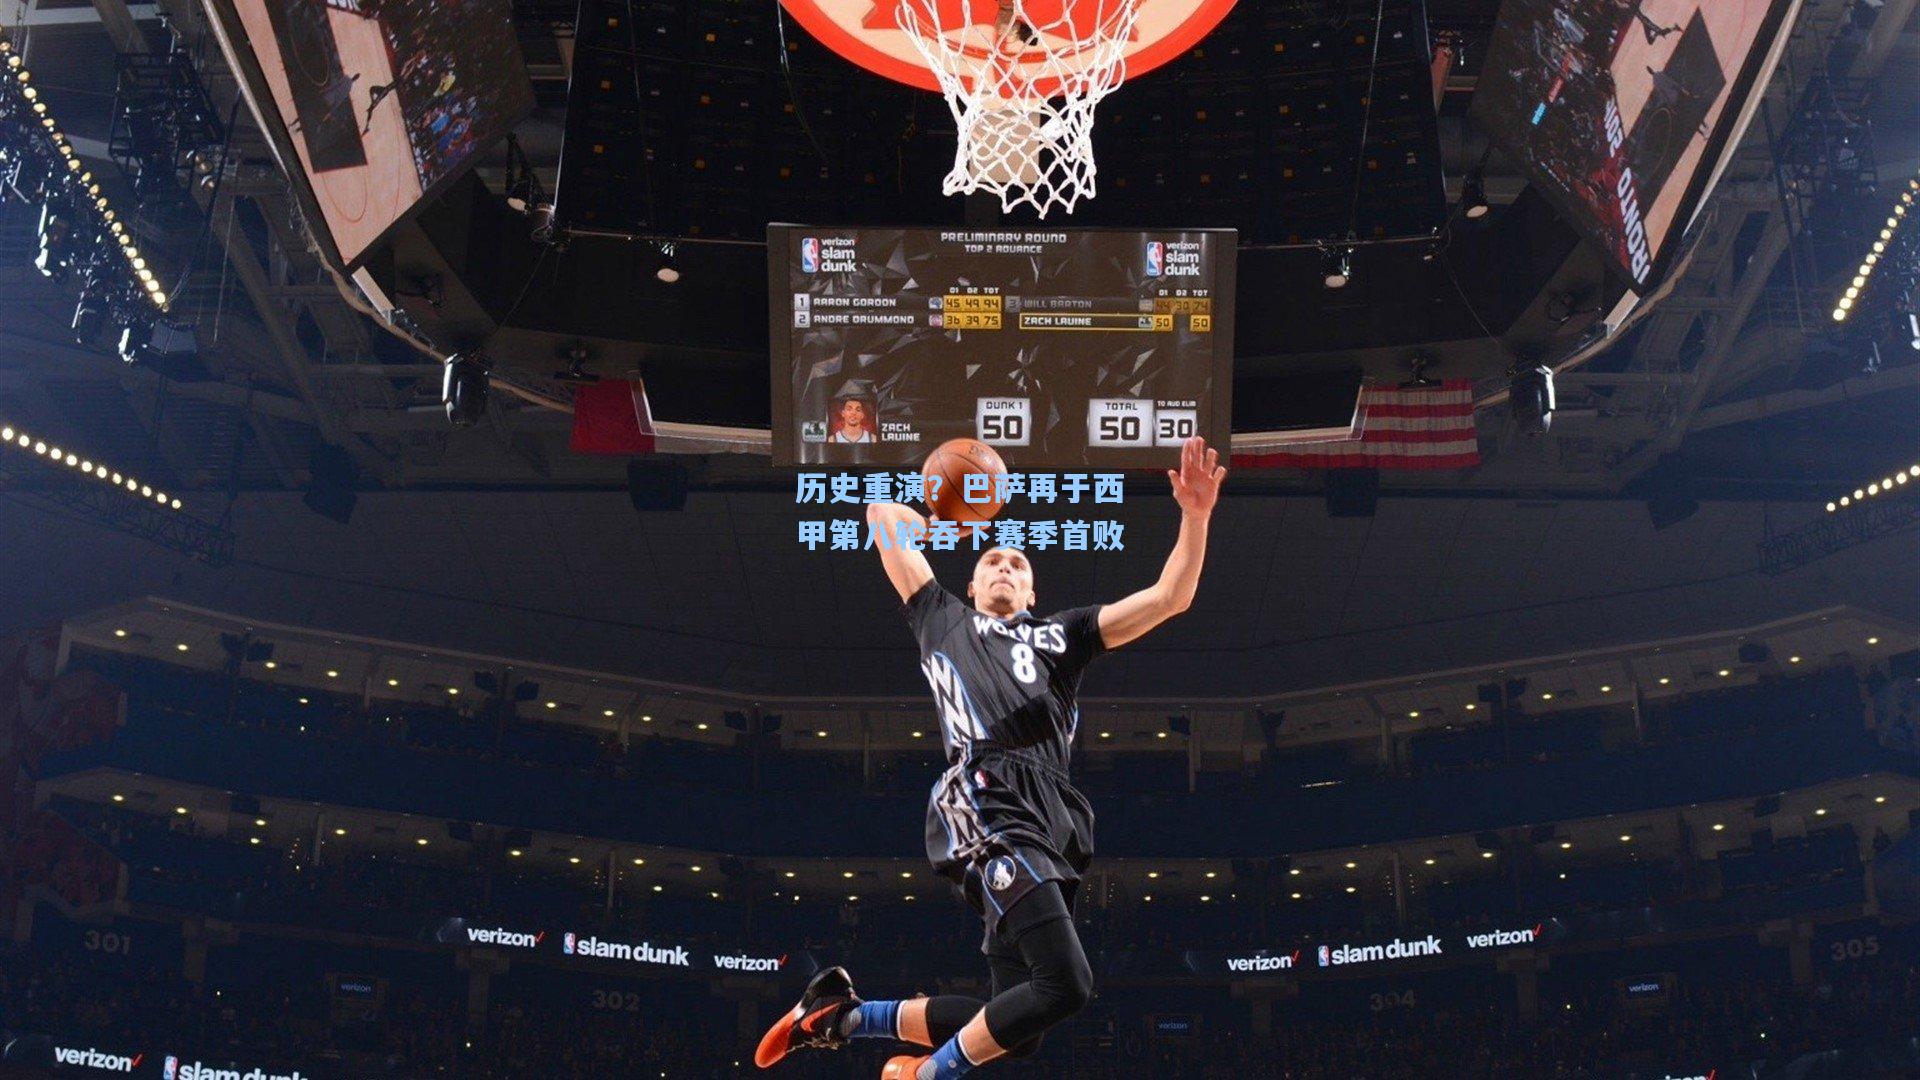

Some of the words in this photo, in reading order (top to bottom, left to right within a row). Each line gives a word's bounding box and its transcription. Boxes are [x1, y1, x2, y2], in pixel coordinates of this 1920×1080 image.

[821, 237, 855, 246] verizon
[940, 232, 1021, 242] PRELIMINARY
[1025, 233, 1067, 243] ROUND
[965, 244, 984, 253] TOP
[986, 245, 993, 253] 2
[1166, 241, 1200, 250] verizon
[821, 246, 855, 259] slam
[1165, 250, 1199, 263] slam
[821, 259, 857, 272] dunk
[1164, 263, 1200, 275] dunk
[800, 297, 805, 307] 1
[813, 298, 850, 307] AARON
[853, 298, 897, 307] GORDON
[946, 299, 960, 307] 45
[965, 299, 980, 307] 49
[983, 299, 999, 308] 94
[799, 315, 807, 324] 2
[813, 315, 849, 324] ANDRE
[853, 315, 915, 324] DRUMMOND
[947, 316, 960, 325] 36
[966, 316, 980, 325] 39
[984, 316, 999, 325] 75
[1024, 317, 1052, 325] ZACH
[1156, 318, 1170, 327] 50
[1193, 318, 1208, 327] 50
[986, 402, 1015, 410] DUNK
[1106, 402, 1138, 410] TOTAL
[881, 423, 911, 432] ZACH
[983, 415, 1023, 440] 50
[1100, 416, 1140, 441] 50
[1159, 418, 1193, 438] 30
[973, 615, 1067, 654] WOLVES
[1011, 643, 1037, 684] 8
[467, 927, 536, 948] verizon
[1466, 929, 1534, 949] verizon
[577, 936, 632, 959] slam
[633, 942, 690, 966] dunk
[1331, 944, 1384, 965] slam
[1385, 935, 1443, 959] dunk
[713, 953, 779, 971] verizon
[1227, 955, 1292, 971] verizon
[340, 982, 372, 993] verizon
[1628, 982, 1660, 992] verizon
[55, 1046, 132, 1072] verizon
[179, 1061, 240, 1080] slam
